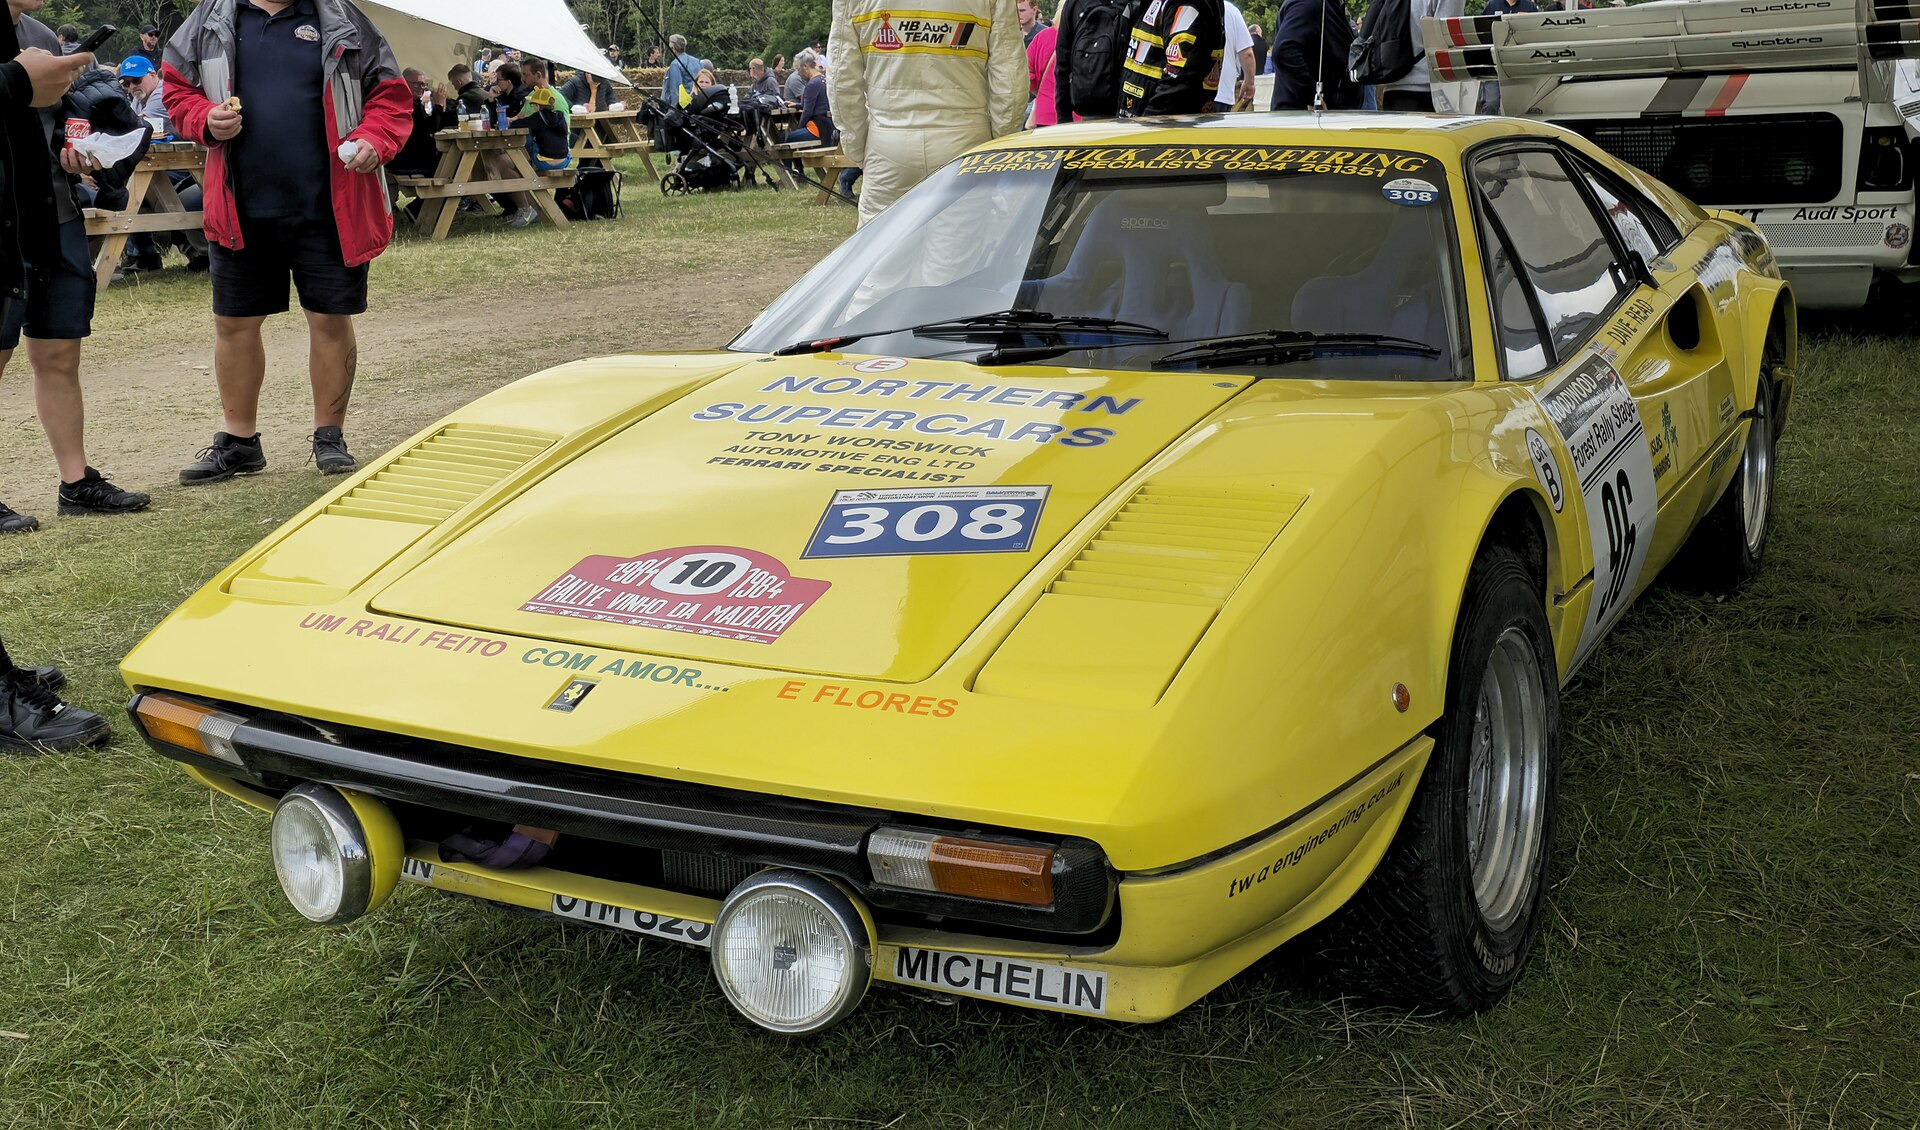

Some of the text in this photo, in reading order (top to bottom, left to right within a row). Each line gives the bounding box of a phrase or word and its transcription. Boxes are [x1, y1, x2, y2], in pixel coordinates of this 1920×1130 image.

[1740, 2, 1831, 14] quattro
[879, 28, 896, 43] HB
[898, 21, 952, 33] HB Audi
[1541, 17, 1586, 27] Audi
[904, 32, 945, 43] TEAM
[1731, 37, 1823, 48] quattro
[1530, 49, 1576, 59] Audi
[957, 160, 1387, 178] FERRARI SPECIALISTS 0254 261351
[958, 149, 1429, 172] WORSWICK ENGINEERING
[1389, 190, 1433, 202] 308
[1120, 217, 1169, 229] sparco
[1792, 206, 1898, 222] Audi Sport
[1607, 298, 1654, 346] DAVE READ
[866, 360, 897, 369] E
[760, 375, 1145, 418] NORTHERN
[692, 402, 1118, 448] SUPERCARS
[1570, 396, 1636, 472] Forest Rally Stage
[722, 445, 976, 470] AUTOMOTIVE ENG LTD
[744, 431, 995, 458] TONY WORSWICK
[1530, 437, 1548, 464] GR
[706, 457, 965, 484] FERRARI SPECIALIST
[1542, 463, 1560, 504] B
[824, 503, 1025, 545] 308
[605, 557, 673, 587] 1984
[669, 559, 737, 588] 10
[727, 567, 786, 599] 1984
[536, 574, 612, 607] RALLYE
[606, 592, 669, 615] VINHO
[666, 602, 702, 620] DA
[701, 603, 804, 633] MADEIRA
[299, 612, 508, 657] UM RALI FEITO
[521, 647, 599, 671] COM
[776, 681, 959, 718] E FLORES
[896, 946, 1103, 1010] MICHELIN
